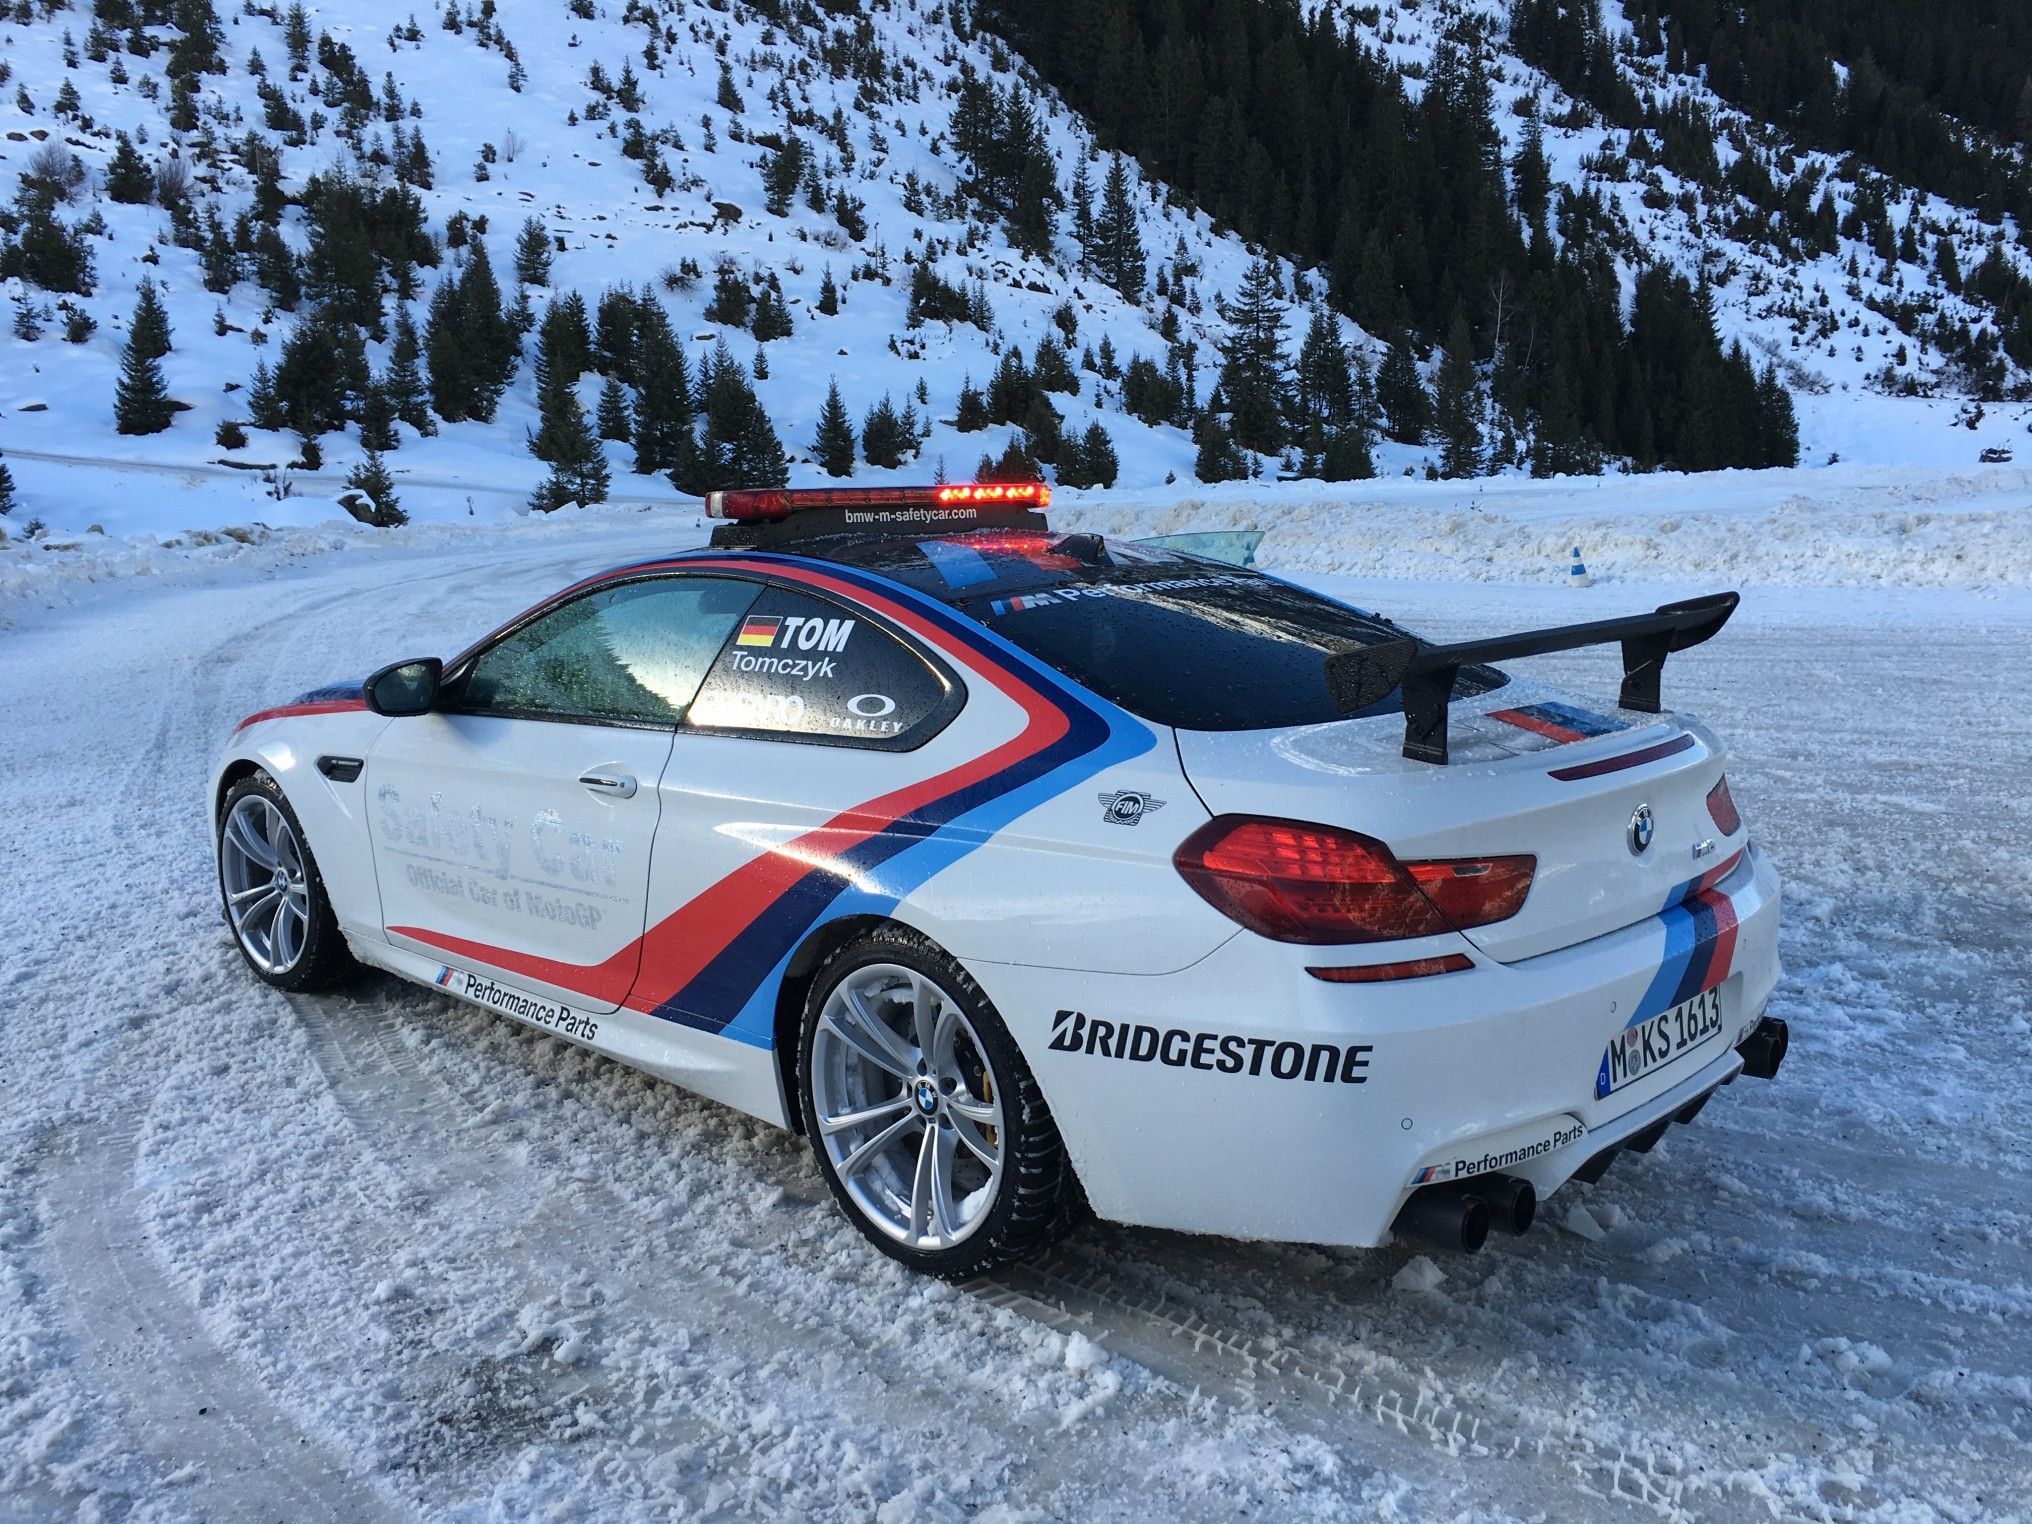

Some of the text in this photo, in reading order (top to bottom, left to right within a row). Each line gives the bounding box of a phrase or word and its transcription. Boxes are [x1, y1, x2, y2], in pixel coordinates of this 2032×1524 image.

[845, 507, 977, 524] bmw-m-safetycar.com
[1053, 577, 1233, 602] Performance
[779, 616, 856, 653] TOM
[730, 651, 838, 681] Tomczyk
[830, 717, 903, 733] OAKLEY
[1115, 800, 1140, 815] FIM
[464, 973, 555, 1025] Performance
[555, 1005, 599, 1041] Parts
[1047, 1009, 1374, 1084] BRIDGESTONE
[1610, 1034, 1628, 1084] M
[1641, 1014, 1671, 1068] KS
[1674, 986, 1720, 1051] 1613
[1454, 1139, 1551, 1178] Performance
[1552, 1123, 1583, 1149] Parts
